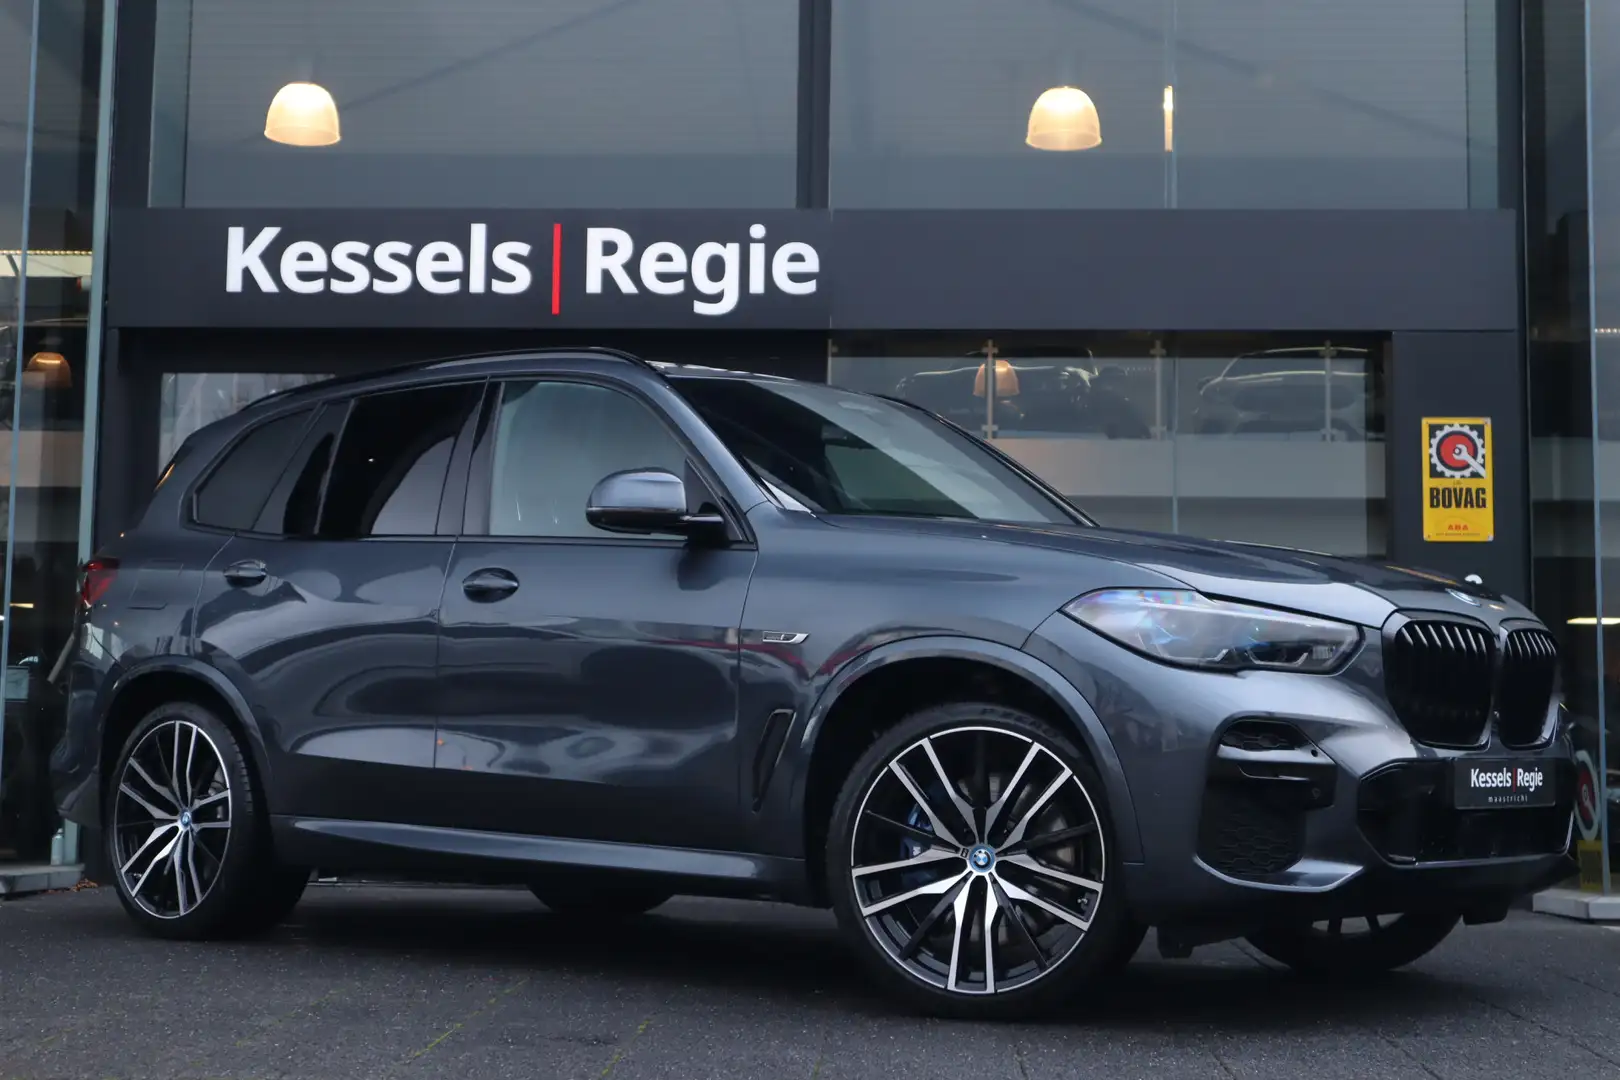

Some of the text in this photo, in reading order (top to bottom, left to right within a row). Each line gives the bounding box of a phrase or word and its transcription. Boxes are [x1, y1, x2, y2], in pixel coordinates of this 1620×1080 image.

[226, 223, 820, 315] Kessels Regie
[1429, 487, 1487, 509] BOVAG
[1470, 767, 1543, 792] Kessels Regie
